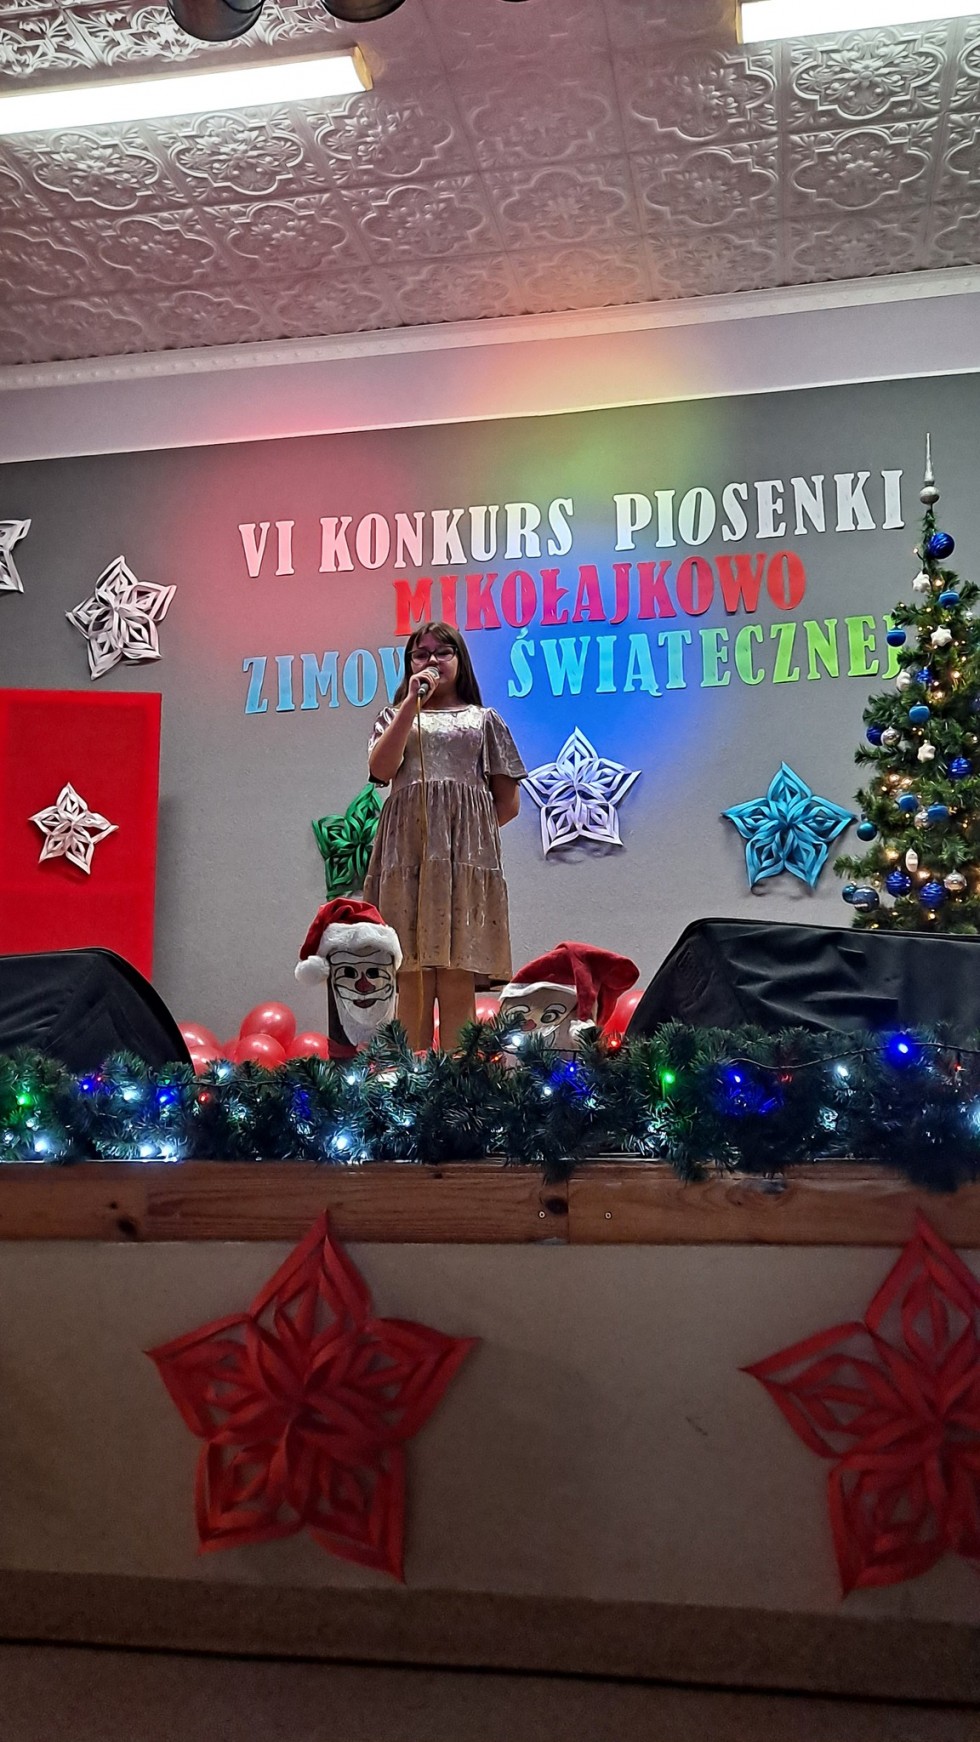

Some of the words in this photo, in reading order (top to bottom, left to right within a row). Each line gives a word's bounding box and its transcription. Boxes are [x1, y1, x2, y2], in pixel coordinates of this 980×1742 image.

[238, 520, 295, 578] VI
[318, 497, 575, 574] KONKURS
[613, 469, 906, 552] PIOSENKI
[392, 550, 807, 637] MIKOŁAJKOWO
[242, 646, 406, 714] ZIMOW
